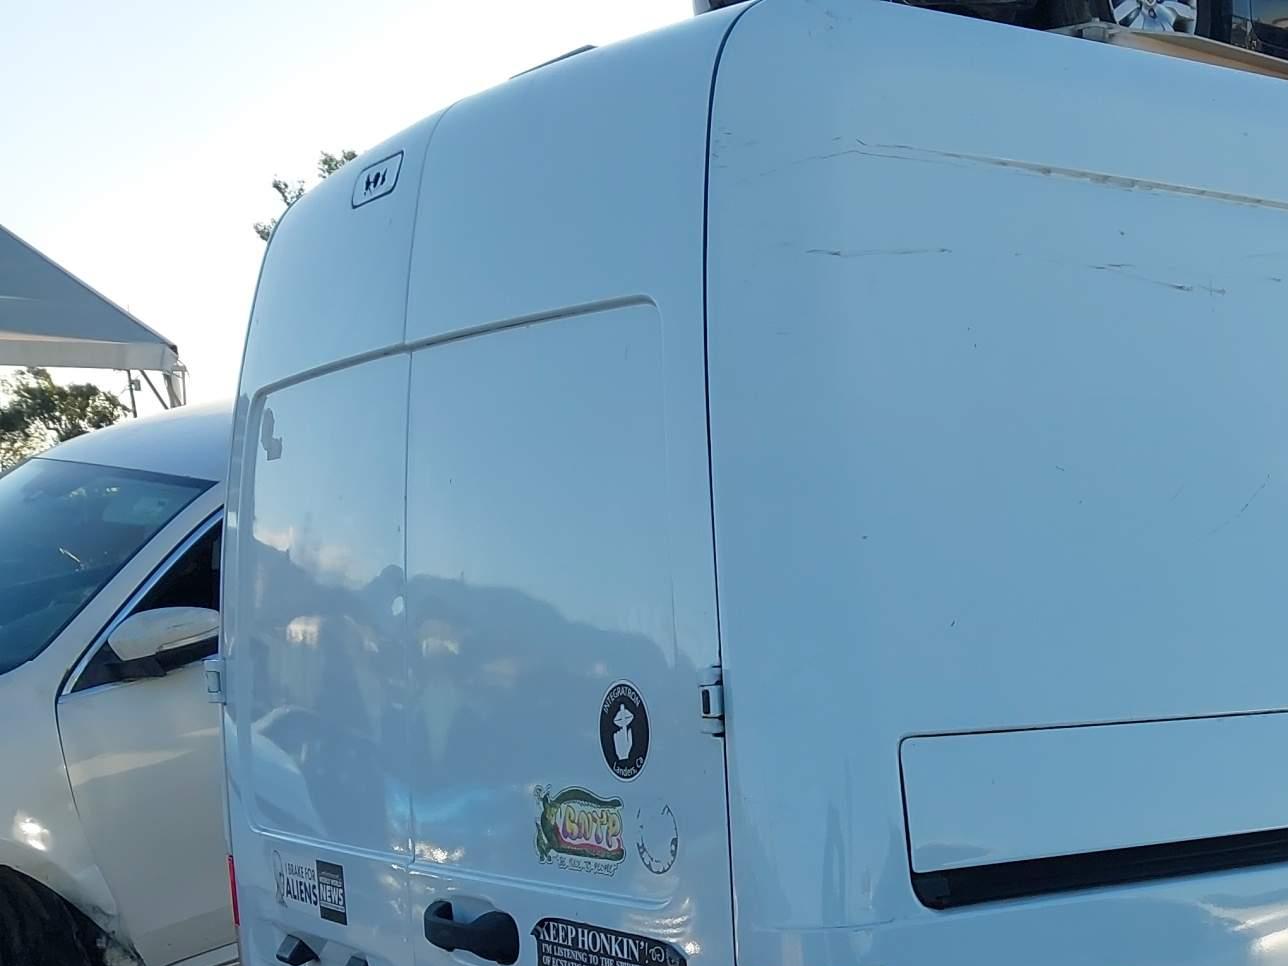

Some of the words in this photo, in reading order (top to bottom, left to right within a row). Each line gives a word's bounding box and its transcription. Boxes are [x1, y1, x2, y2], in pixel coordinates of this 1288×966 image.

[603, 686, 641, 714] INTEGRATRON
[287, 863, 304, 878] BRAKE
[305, 866, 316, 881] FOR
[286, 876, 318, 907] ALIENS
[320, 883, 344, 906] NEWS
[540, 921, 576, 948] KEEP
[542, 956, 551, 965] OF
[553, 944, 588, 963] LISTENING
[588, 954, 599, 965] TO
